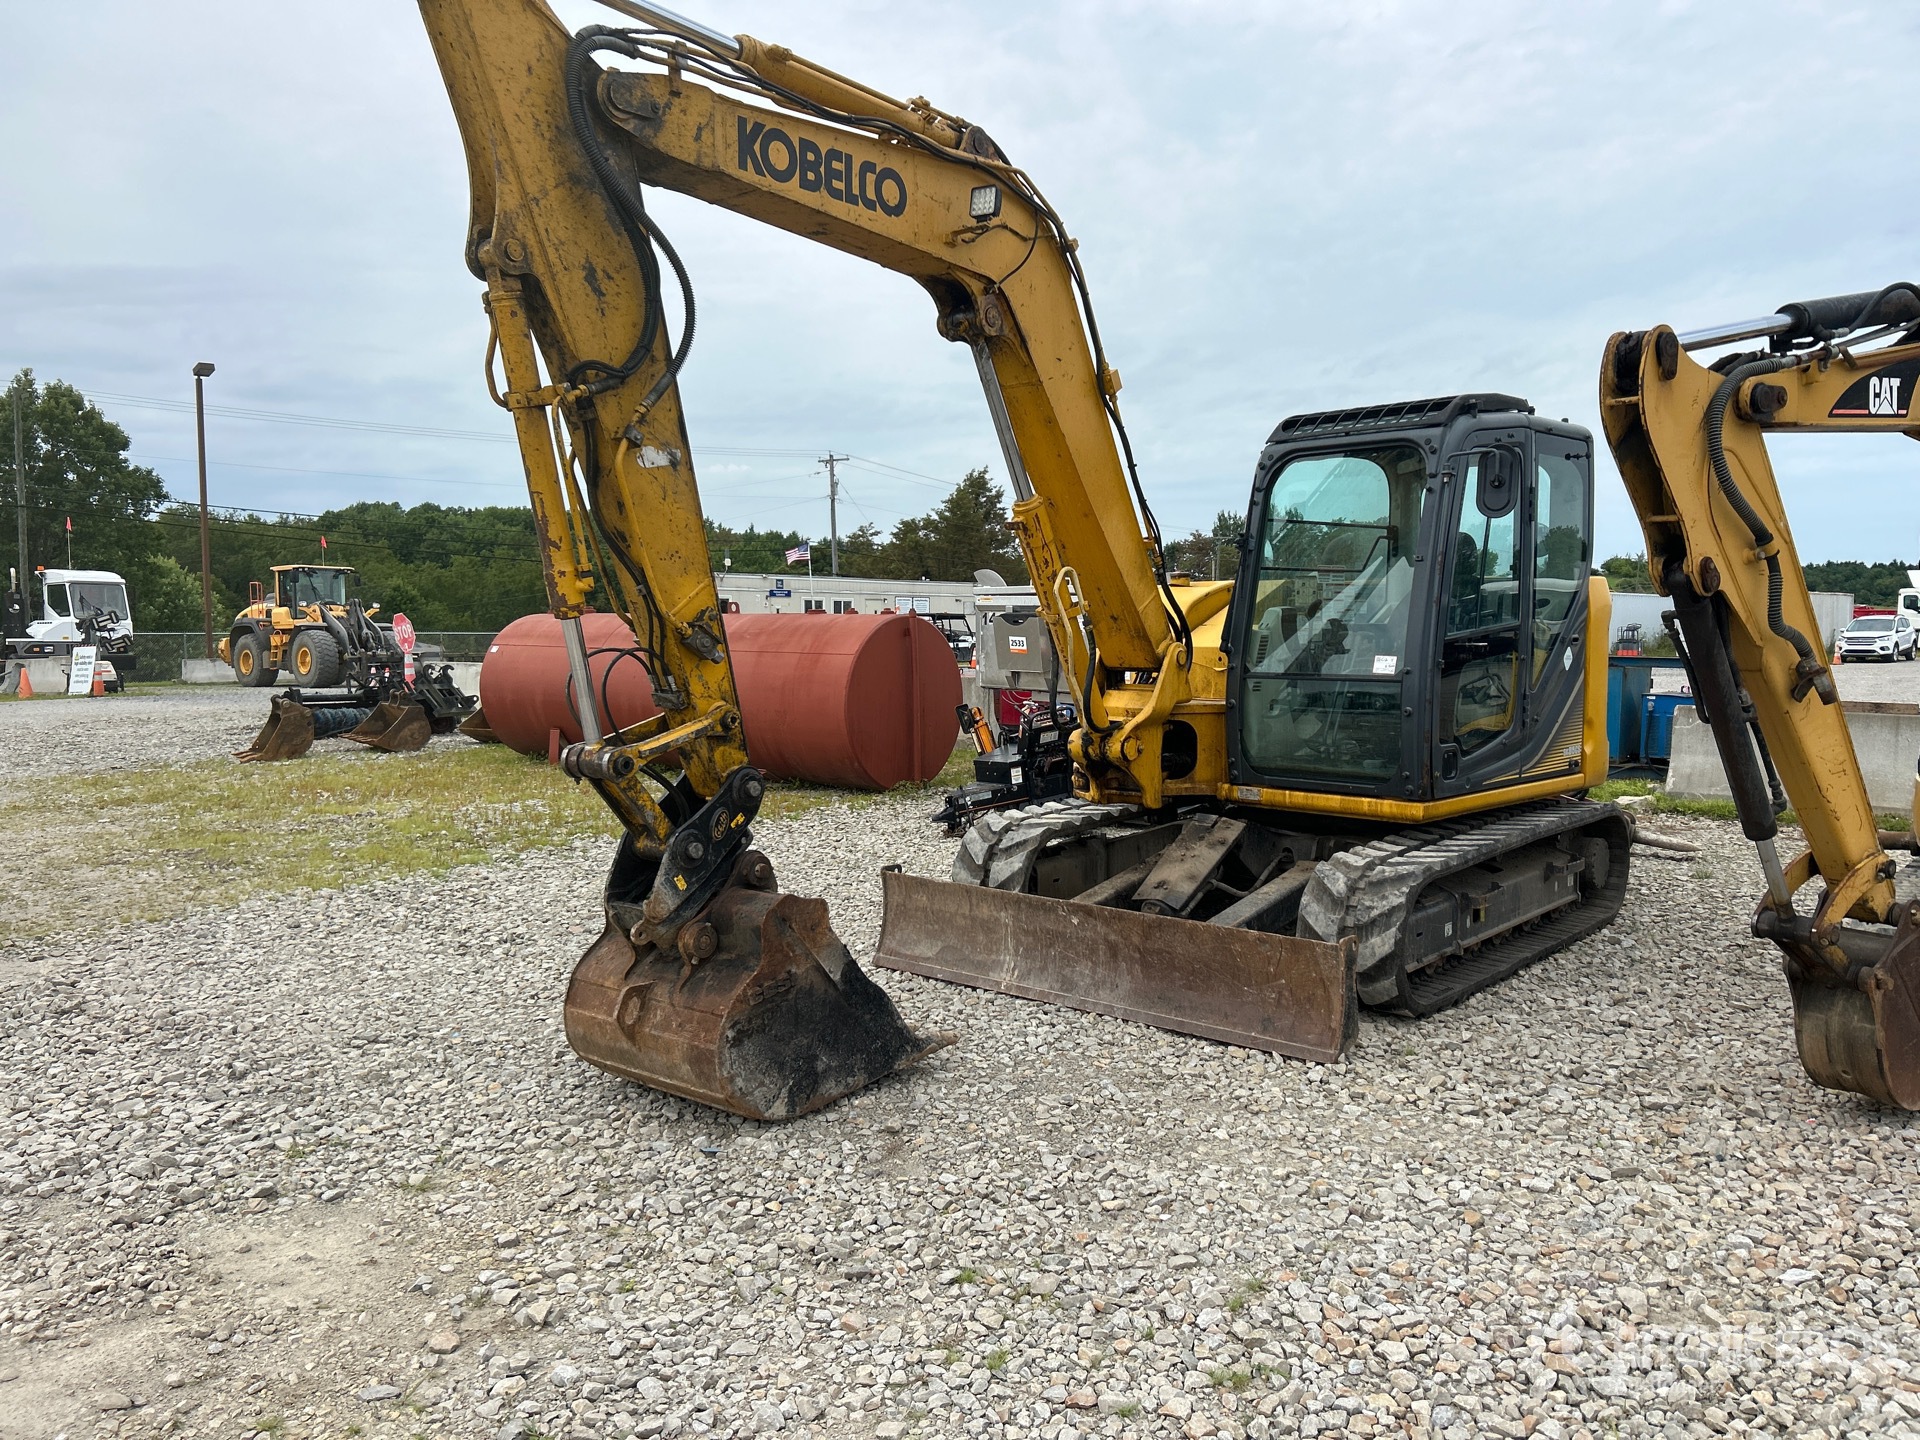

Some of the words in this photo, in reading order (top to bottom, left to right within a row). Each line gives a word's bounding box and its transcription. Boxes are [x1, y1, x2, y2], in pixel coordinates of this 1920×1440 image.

[736, 115, 908, 218] KOBELCO
[1869, 376, 1901, 414] CAT
[394, 624, 412, 640] STOP
[1010, 639, 1025, 648] 2533
